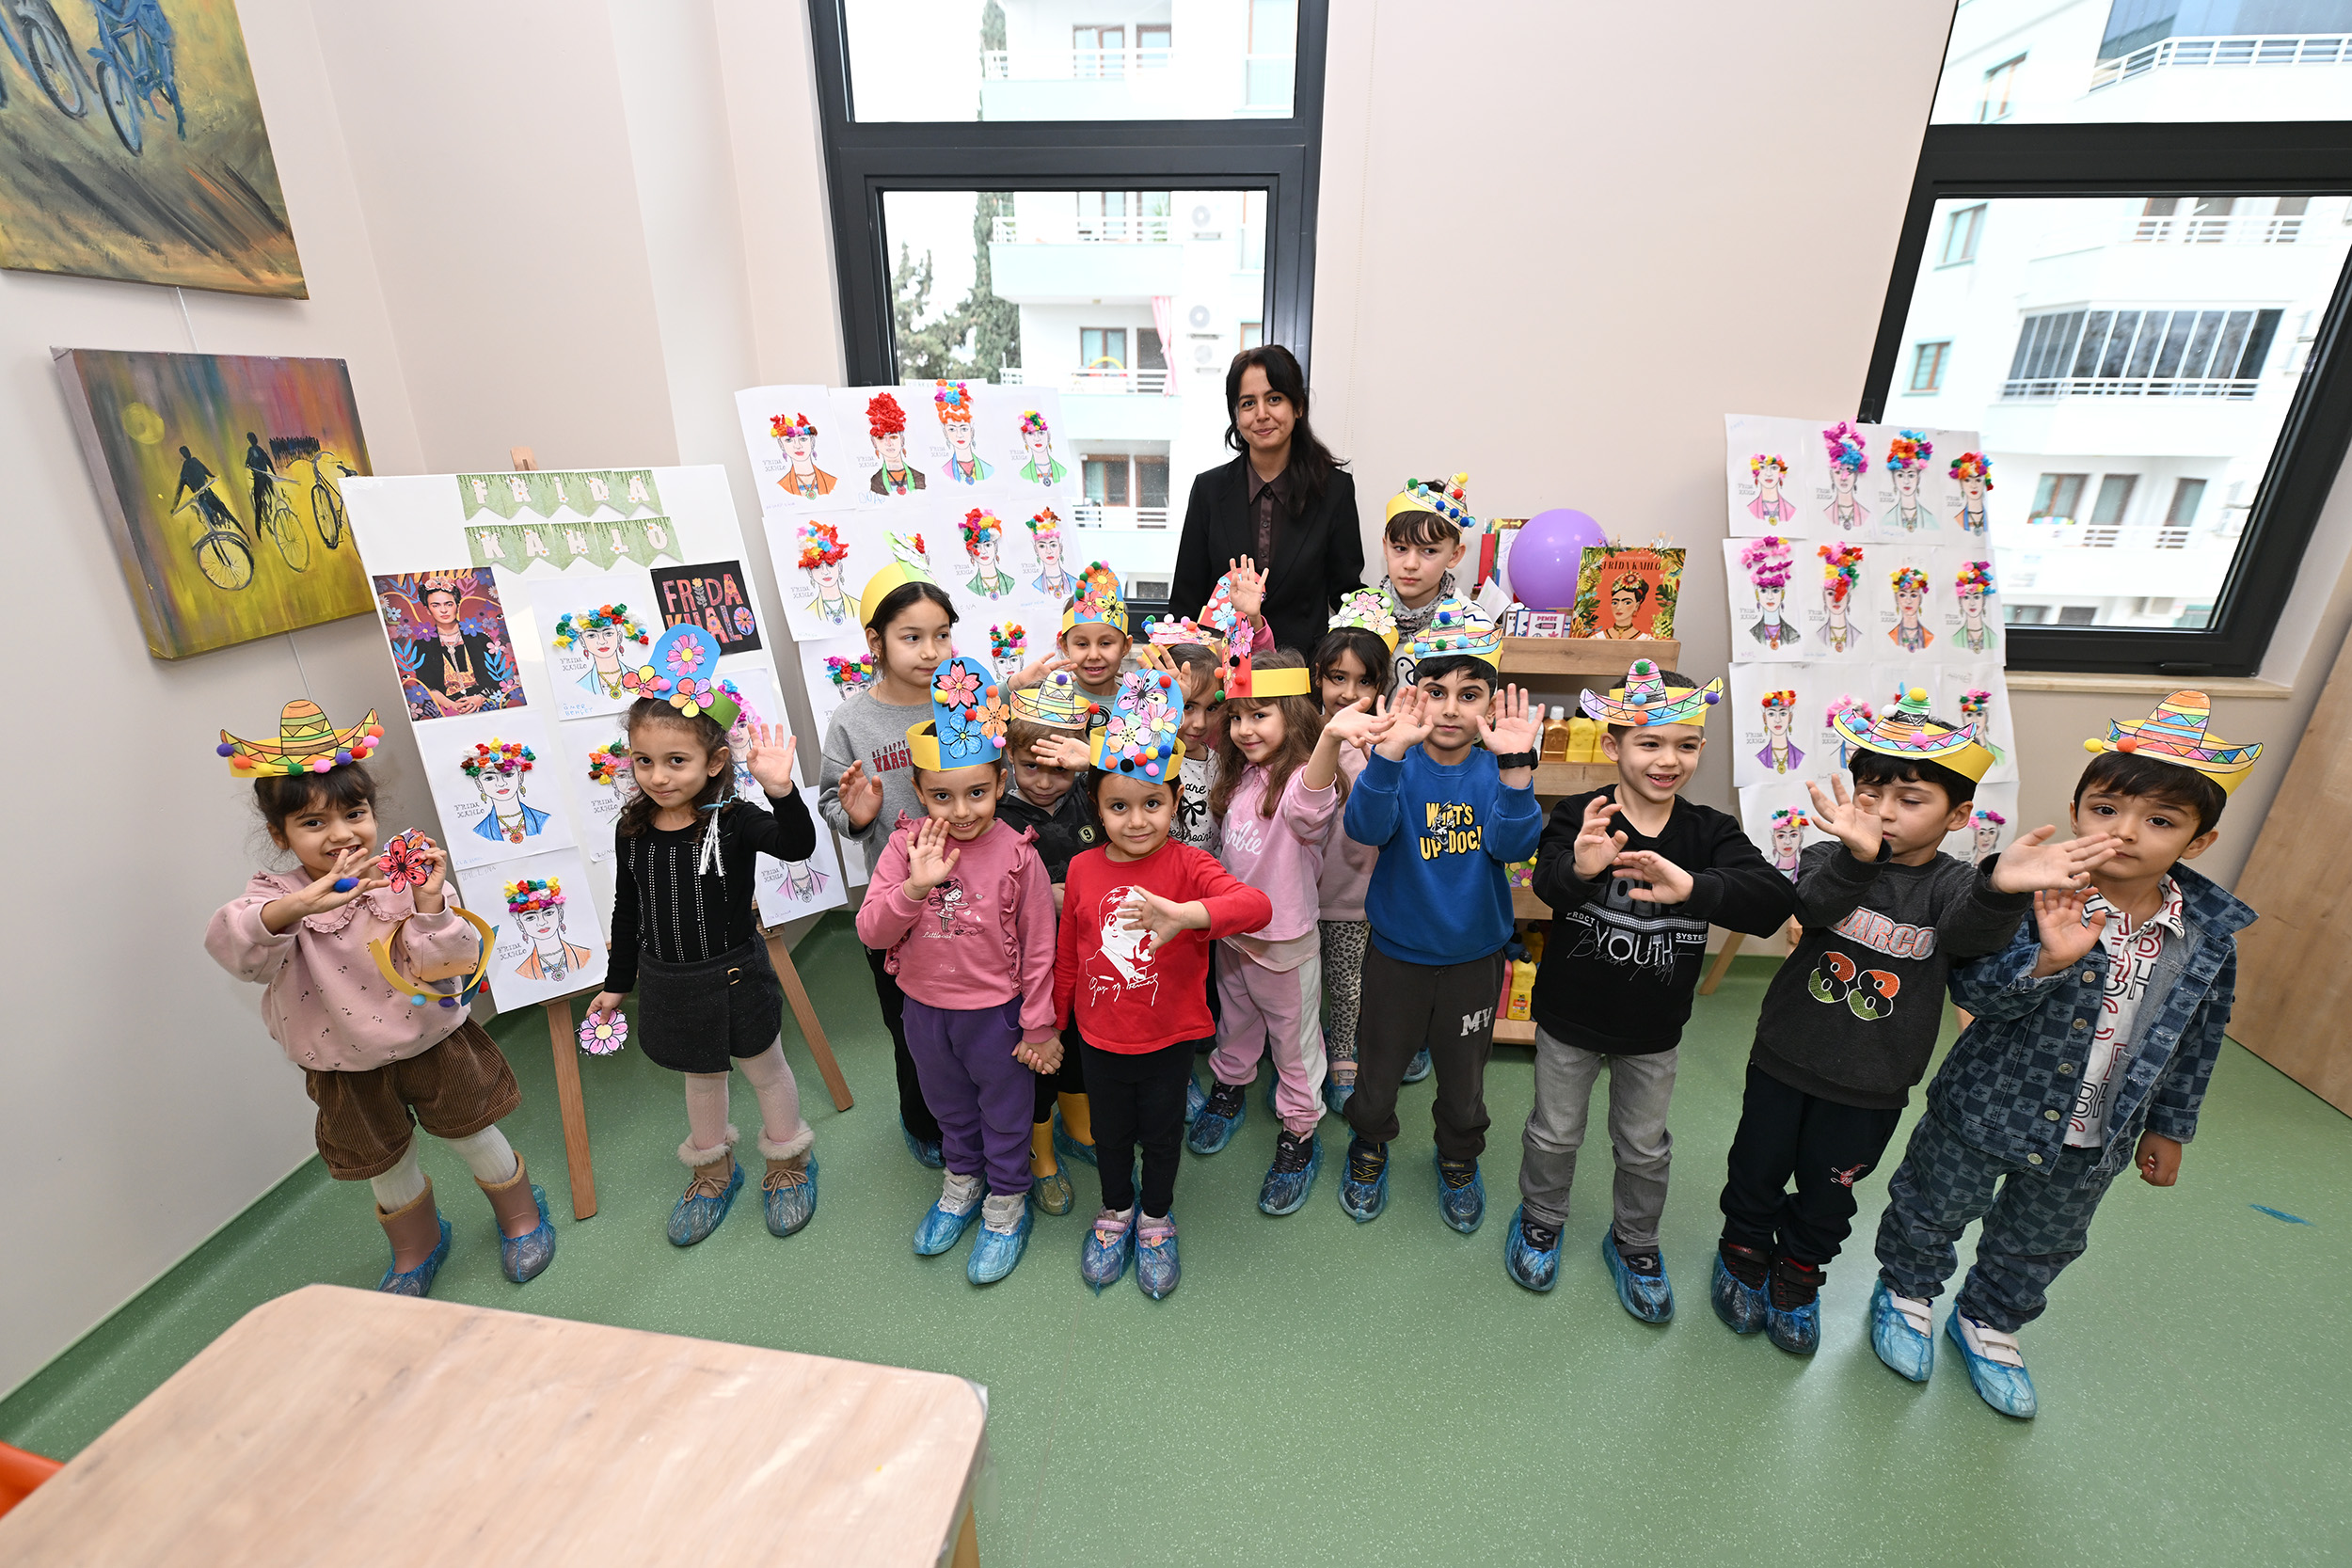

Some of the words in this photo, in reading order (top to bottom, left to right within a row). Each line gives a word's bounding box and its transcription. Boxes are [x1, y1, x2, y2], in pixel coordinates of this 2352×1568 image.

[883, 739, 906, 753] HAPPY
[873, 748, 913, 772] VARSI
[1185, 783, 1206, 794] are
[1419, 836, 1442, 861] UP
[1449, 825, 1483, 854] DOC!
[1597, 921, 1673, 966] YOUTH
